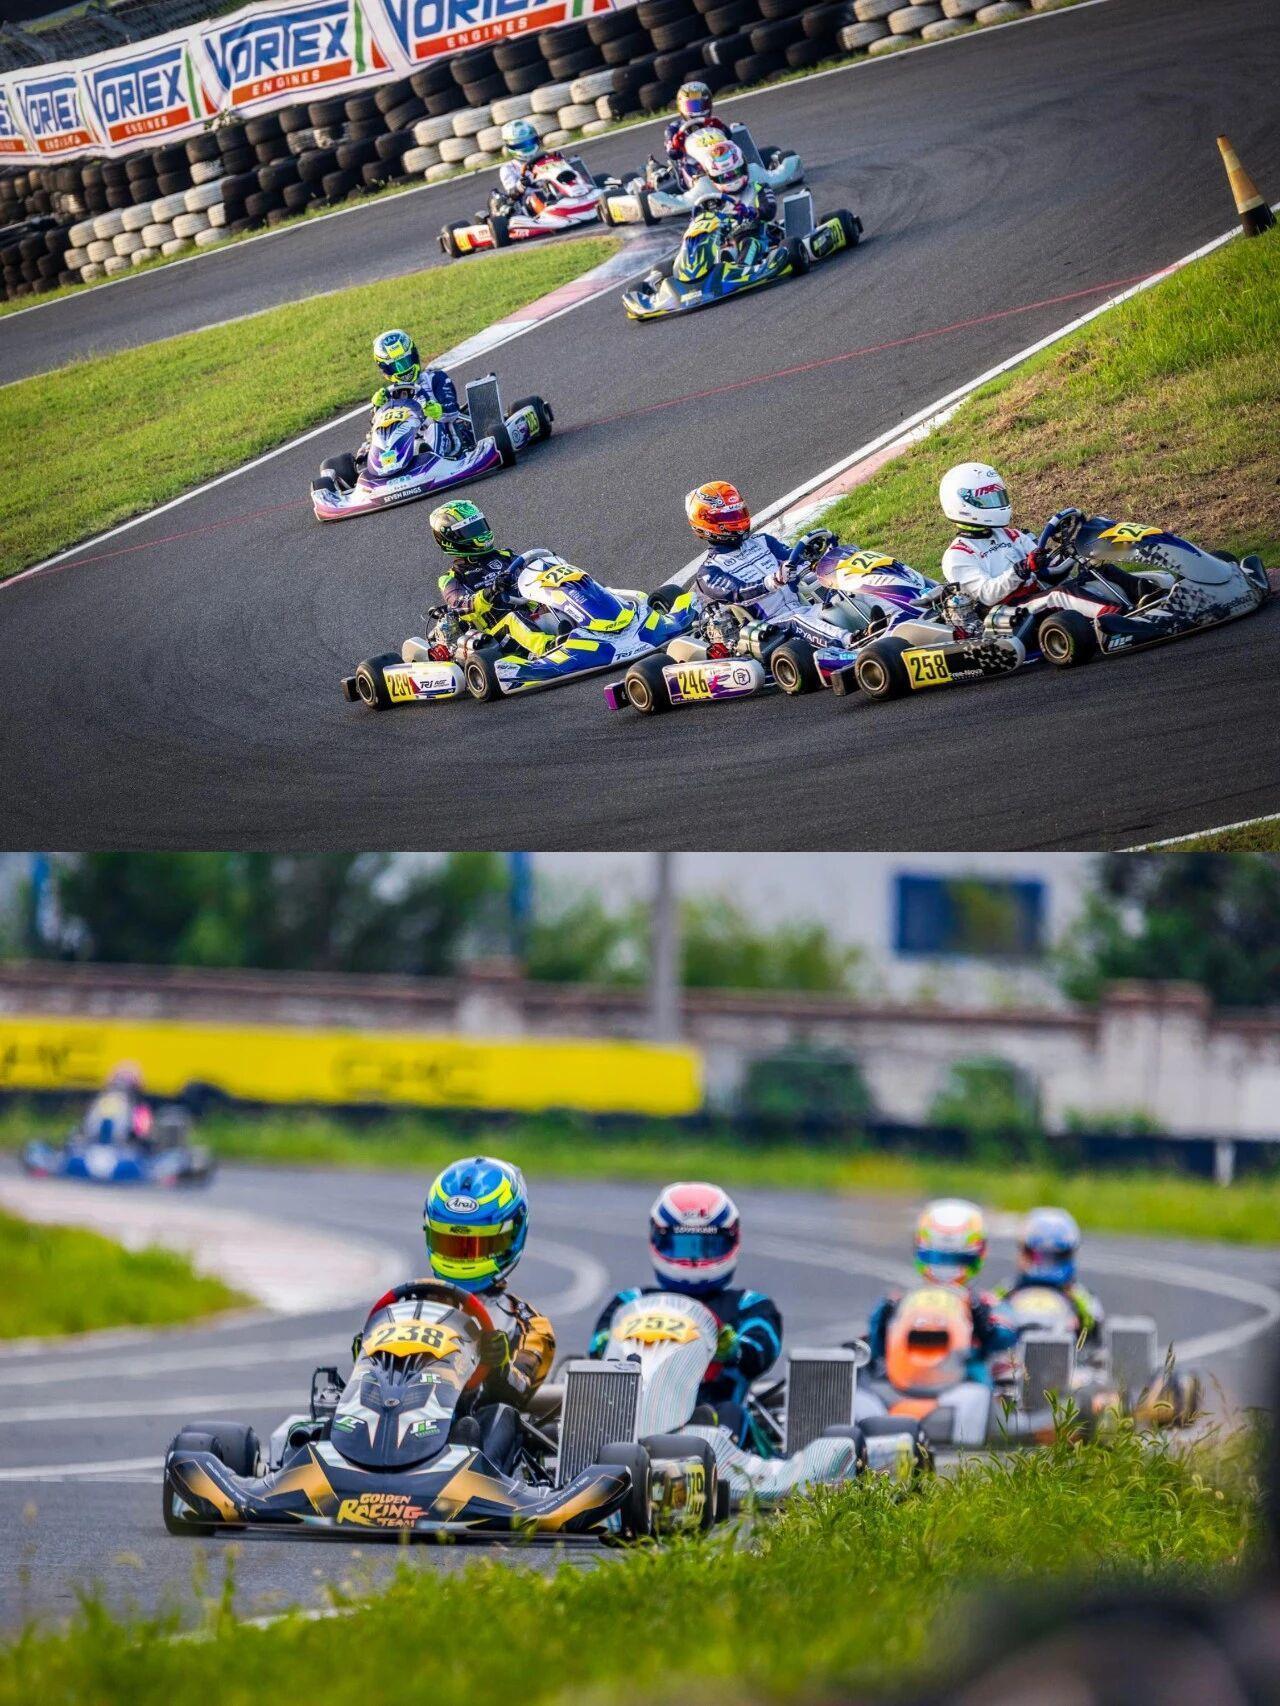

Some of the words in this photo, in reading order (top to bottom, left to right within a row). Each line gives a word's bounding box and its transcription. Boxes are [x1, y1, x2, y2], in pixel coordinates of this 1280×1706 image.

[446, 17, 528, 48] ENGINES
[204, 2, 350, 91] VORTEX
[84, 48, 186, 141] VORTEX
[251, 70, 320, 96] ENGINES
[16, 77, 80, 135] VORTE
[124, 116, 168, 135] ENGINES
[384, 491, 403, 503] SEVEN
[403, 487, 421, 499] RINGS
[910, 655, 949, 682] 258
[678, 669, 709, 695] 246
[452, 1198, 473, 1209] Arai
[374, 1325, 445, 1349] 238
[626, 1316, 686, 1335] 252
[360, 1493, 411, 1504] GOLDEN
[337, 1499, 429, 1527] RACING
[377, 1517, 415, 1528] TEAM
